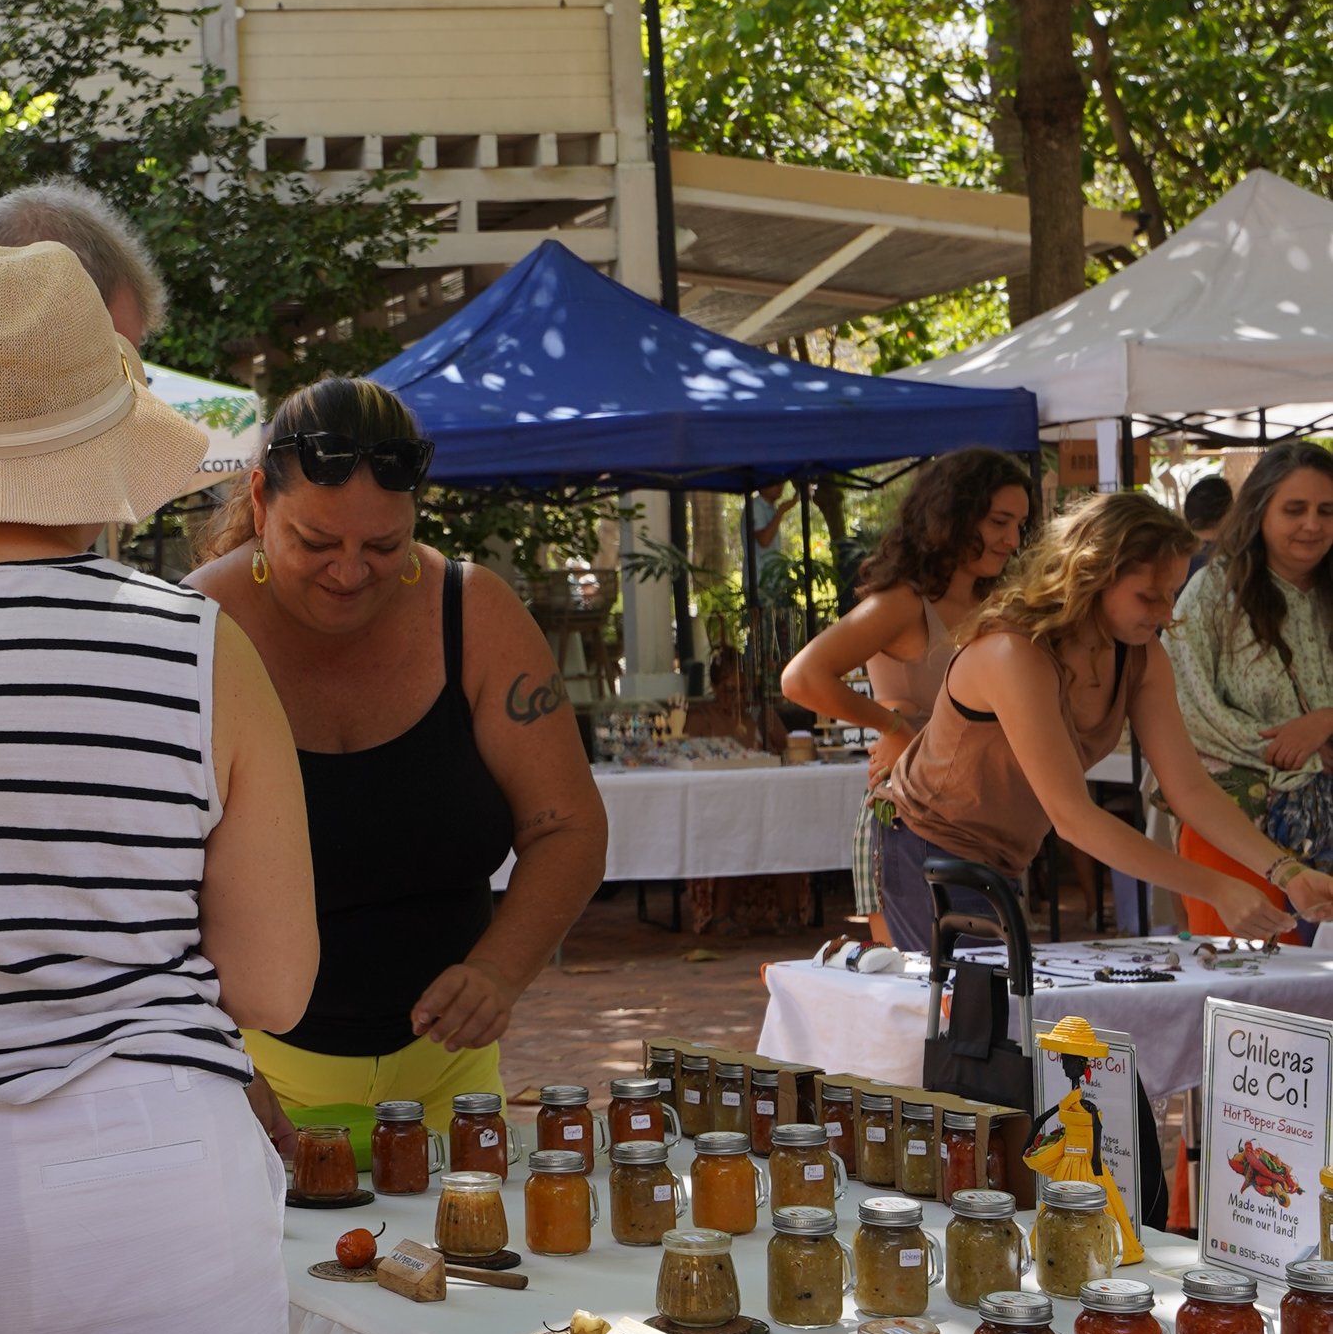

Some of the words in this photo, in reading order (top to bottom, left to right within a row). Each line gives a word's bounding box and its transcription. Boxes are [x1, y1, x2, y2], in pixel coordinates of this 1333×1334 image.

[1105, 1056, 1126, 1074] Co!
[1228, 1029, 1314, 1074] Chileras
[1233, 1065, 1259, 1096] de
[1267, 1072, 1308, 1108] Co!
[1223, 1104, 1241, 1120] Hot
[1243, 1109, 1276, 1131] Pepper
[1277, 1118, 1313, 1139] Sauces
[1228, 1193, 1255, 1213] Made
[1258, 1203, 1277, 1219] with
[1279, 1208, 1299, 1226] love
[1232, 1209, 1253, 1226] from
[1256, 1220, 1271, 1231] our
[1273, 1221, 1297, 1239] land!
[1239, 1247, 1280, 1267] 8515-5345
